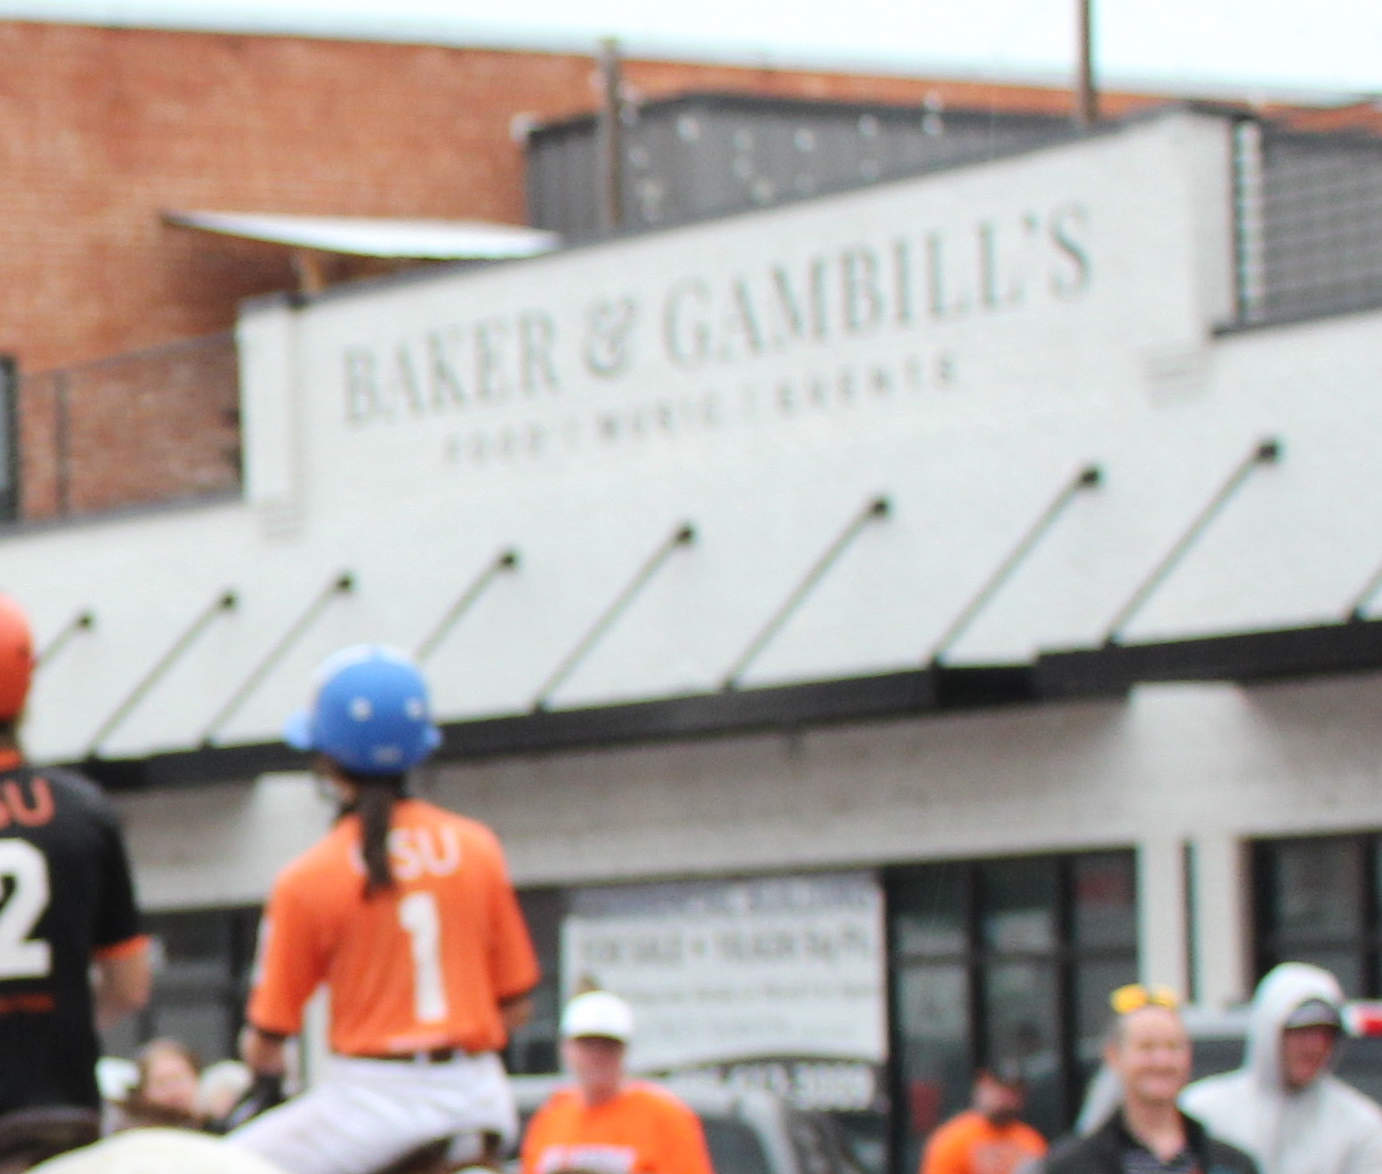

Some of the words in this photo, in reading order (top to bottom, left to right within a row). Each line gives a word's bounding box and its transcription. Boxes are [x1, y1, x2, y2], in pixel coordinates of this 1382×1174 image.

[342, 306, 563, 430] BAKER
[582, 294, 640, 380] &
[662, 202, 1093, 373] GAMBILL'S
[348, 822, 461, 882] SU
[398, 890, 449, 1025] 1
